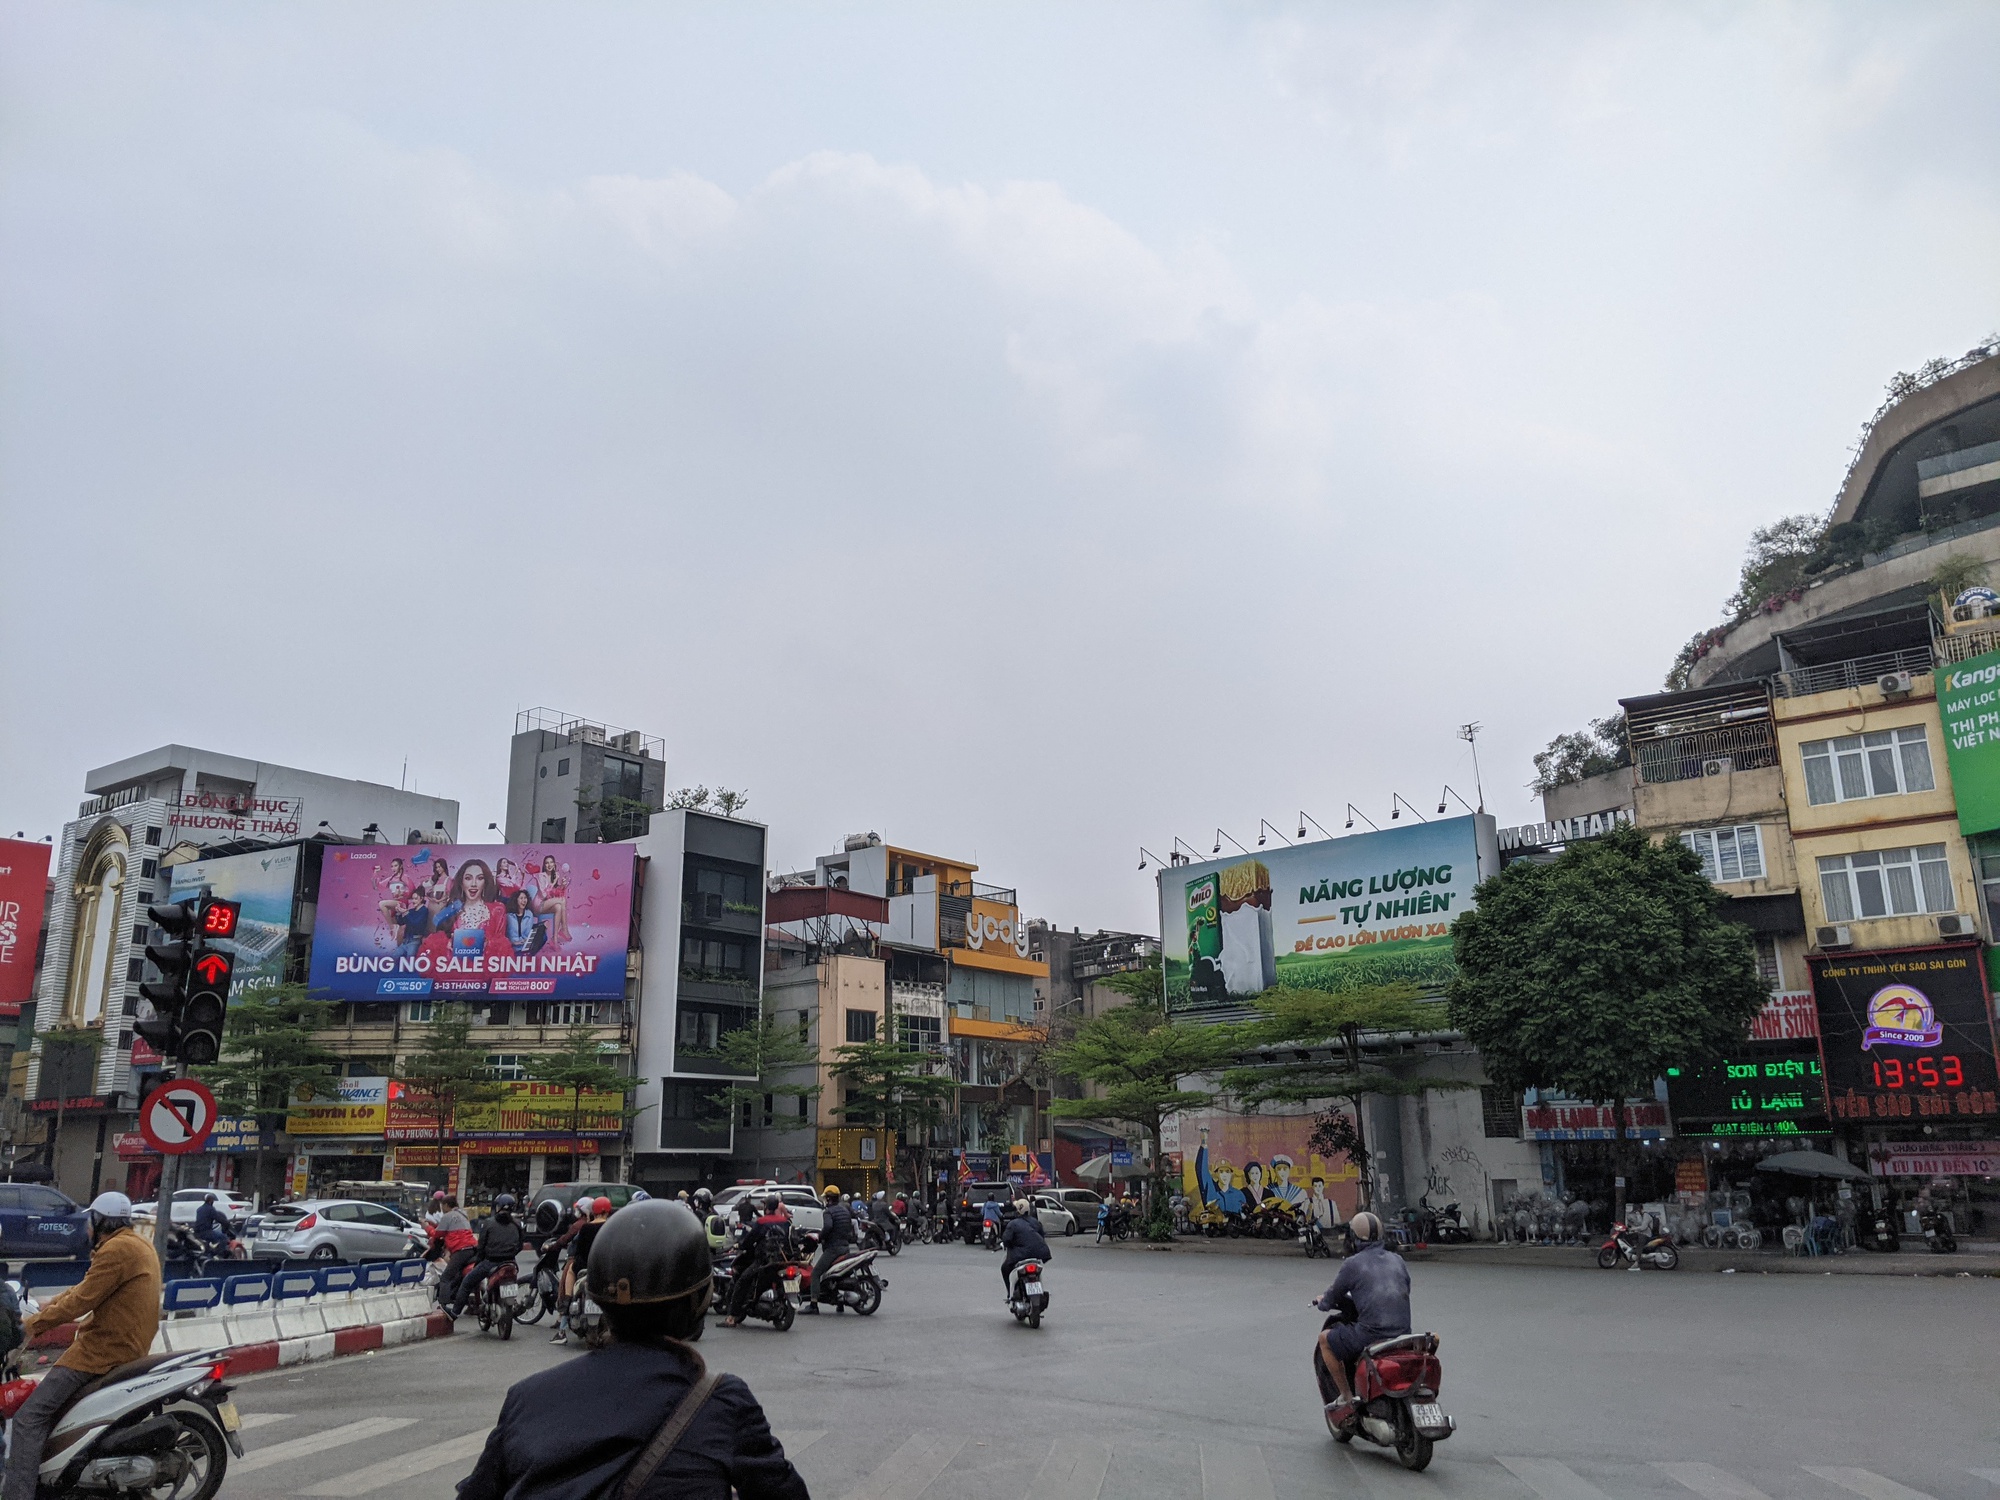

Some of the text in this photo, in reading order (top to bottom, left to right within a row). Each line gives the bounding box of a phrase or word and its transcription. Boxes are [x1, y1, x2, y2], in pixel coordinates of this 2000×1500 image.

[1946, 690, 1996, 714] MÁY LỌC
[1951, 718, 1976, 735] THỊ
[1953, 731, 1985, 750] VIỆT
[169, 814, 298, 833] PHƯƠNG THẢO
[350, 852, 377, 861] Lazada
[1299, 864, 1453, 904] NĂNG LƯỢNG
[1190, 888, 1212, 907] MILO
[205, 904, 232, 931] 33
[1339, 902, 1372, 928] TỰ
[966, 910, 1030, 958] yody
[1294, 935, 1314, 953] ĐỂ
[1315, 932, 1345, 950] CAO
[1348, 927, 1378, 946] LỚN
[1425, 922, 1447, 936] XA
[455, 948, 481, 956] Lazada
[335, 949, 597, 977] BÙNG NỔ SALE SINH NHẬT
[1849, 966, 1861, 976] TY
[1862, 964, 1887, 975] TNHH
[434, 980, 488, 991] 3-13 THÁNG 3
[1773, 994, 1812, 1009] LẠNH
[1880, 1030, 1925, 1042] Since 2009
[1764, 1060, 1804, 1079] ĐIỆN
[1873, 1055, 1964, 1089] 13:53
[337, 1088, 383, 1098] DVANCE
[1834, 1087, 1871, 1118] YẾN
[350, 1105, 375, 1118] LỐP
[239, 1119, 260, 1132] CH
[1740, 1121, 1764, 1134] ĐIỆN
[1765, 1123, 1772, 1132] 4
[463, 1140, 477, 1149] 45
[581, 1139, 593, 1148] 14
